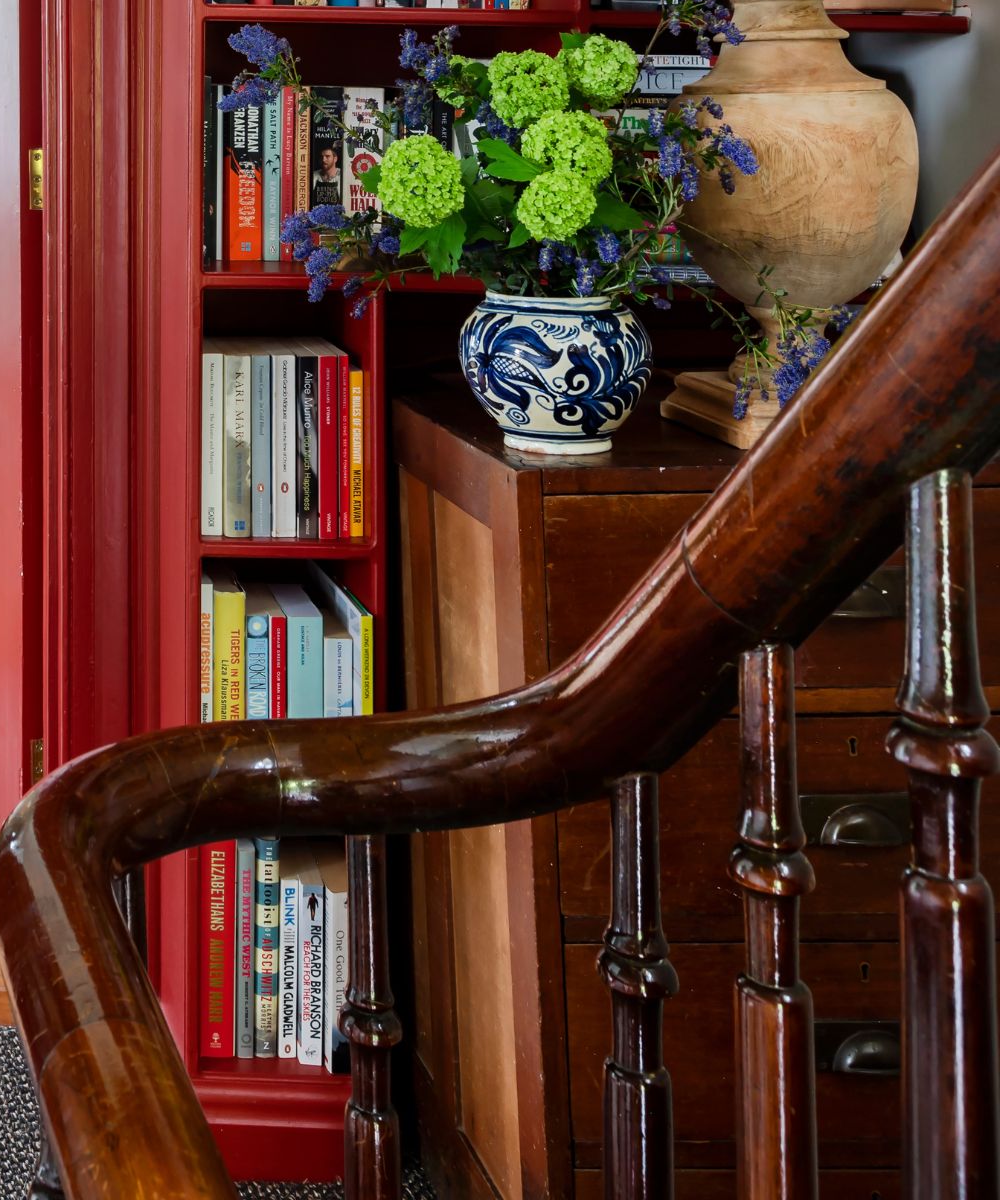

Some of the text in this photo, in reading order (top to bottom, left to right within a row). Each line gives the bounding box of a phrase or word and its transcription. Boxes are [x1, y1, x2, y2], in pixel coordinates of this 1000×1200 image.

[247, 104, 259, 153] JONATHAN
[269, 109, 277, 150] SALT PATH
[298, 112, 307, 153] JACKSON
[349, 198, 377, 211] HALL
[235, 371, 244, 403] KARL
[303, 370, 313, 429] Alice Munro
[235, 411, 245, 448] MARX
[352, 469, 361, 498] MICHAEL
[200, 612, 211, 695] acupressure
[220, 660, 229, 677] Liza
[230, 628, 241, 702] TIGERS RED
[248, 653, 266, 690] BROKEN
[209, 850, 226, 932] ELIZABETHANS
[284, 887, 296, 926] BLINK
[260, 937, 273, 1005] AUSCHWITZ
[303, 940, 311, 964] REACH
[282, 945, 295, 1039] MALCOLM GLADWELL
[302, 983, 310, 999] THE
[309, 925, 322, 1040] RICHARD BRANSON
[302, 1000, 310, 1022] SKIES
